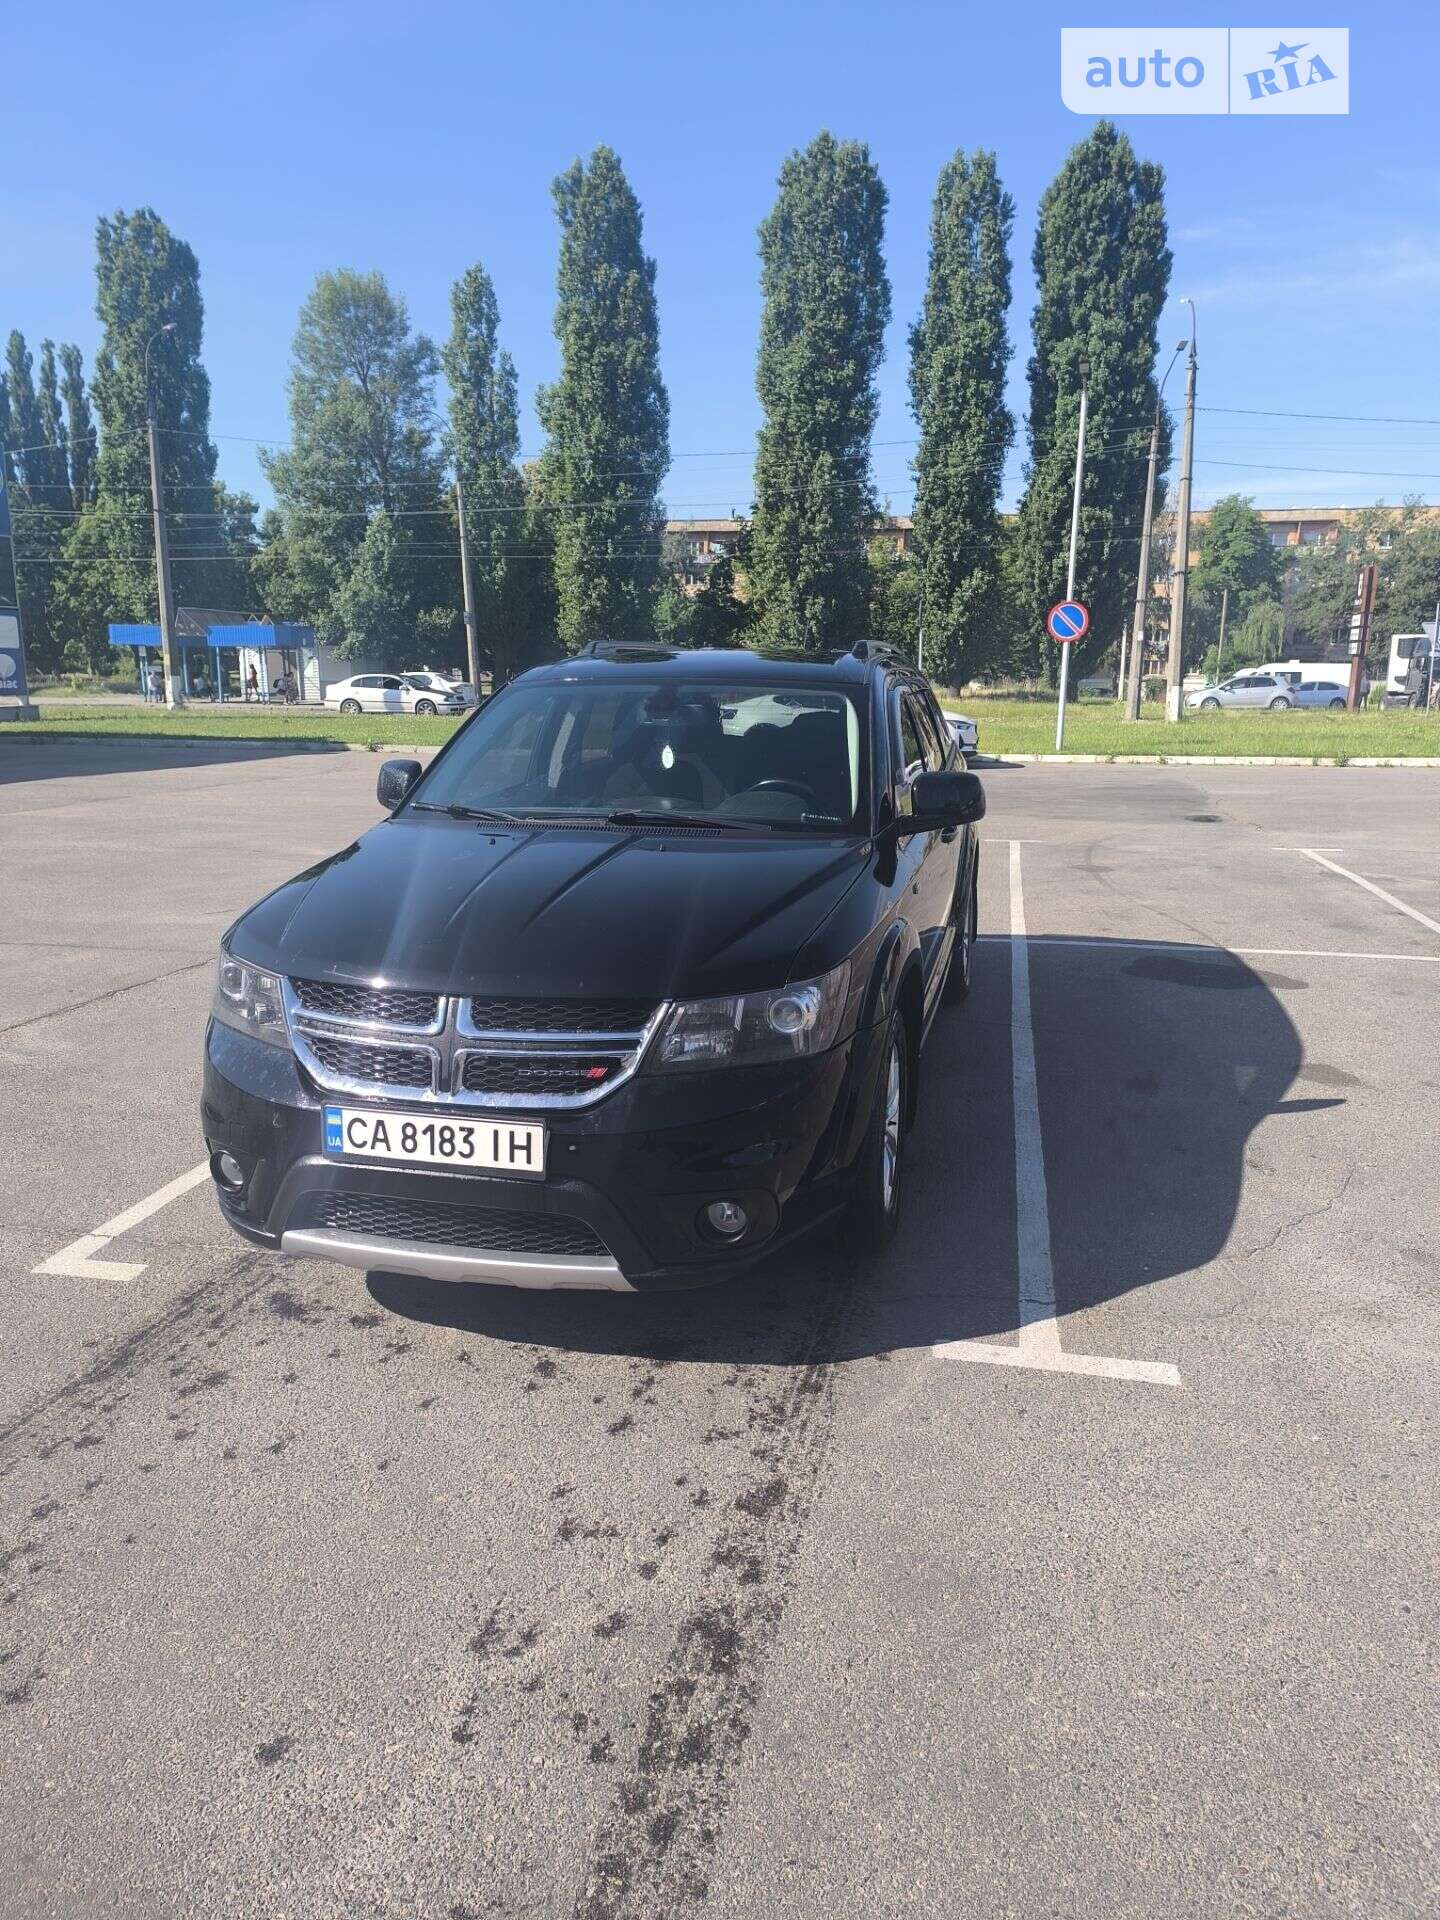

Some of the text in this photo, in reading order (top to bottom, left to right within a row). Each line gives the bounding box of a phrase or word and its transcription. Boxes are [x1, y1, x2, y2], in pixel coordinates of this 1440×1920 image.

[328, 1135, 342, 1147] UA
[346, 1117, 532, 1165] CA 8183 IH
